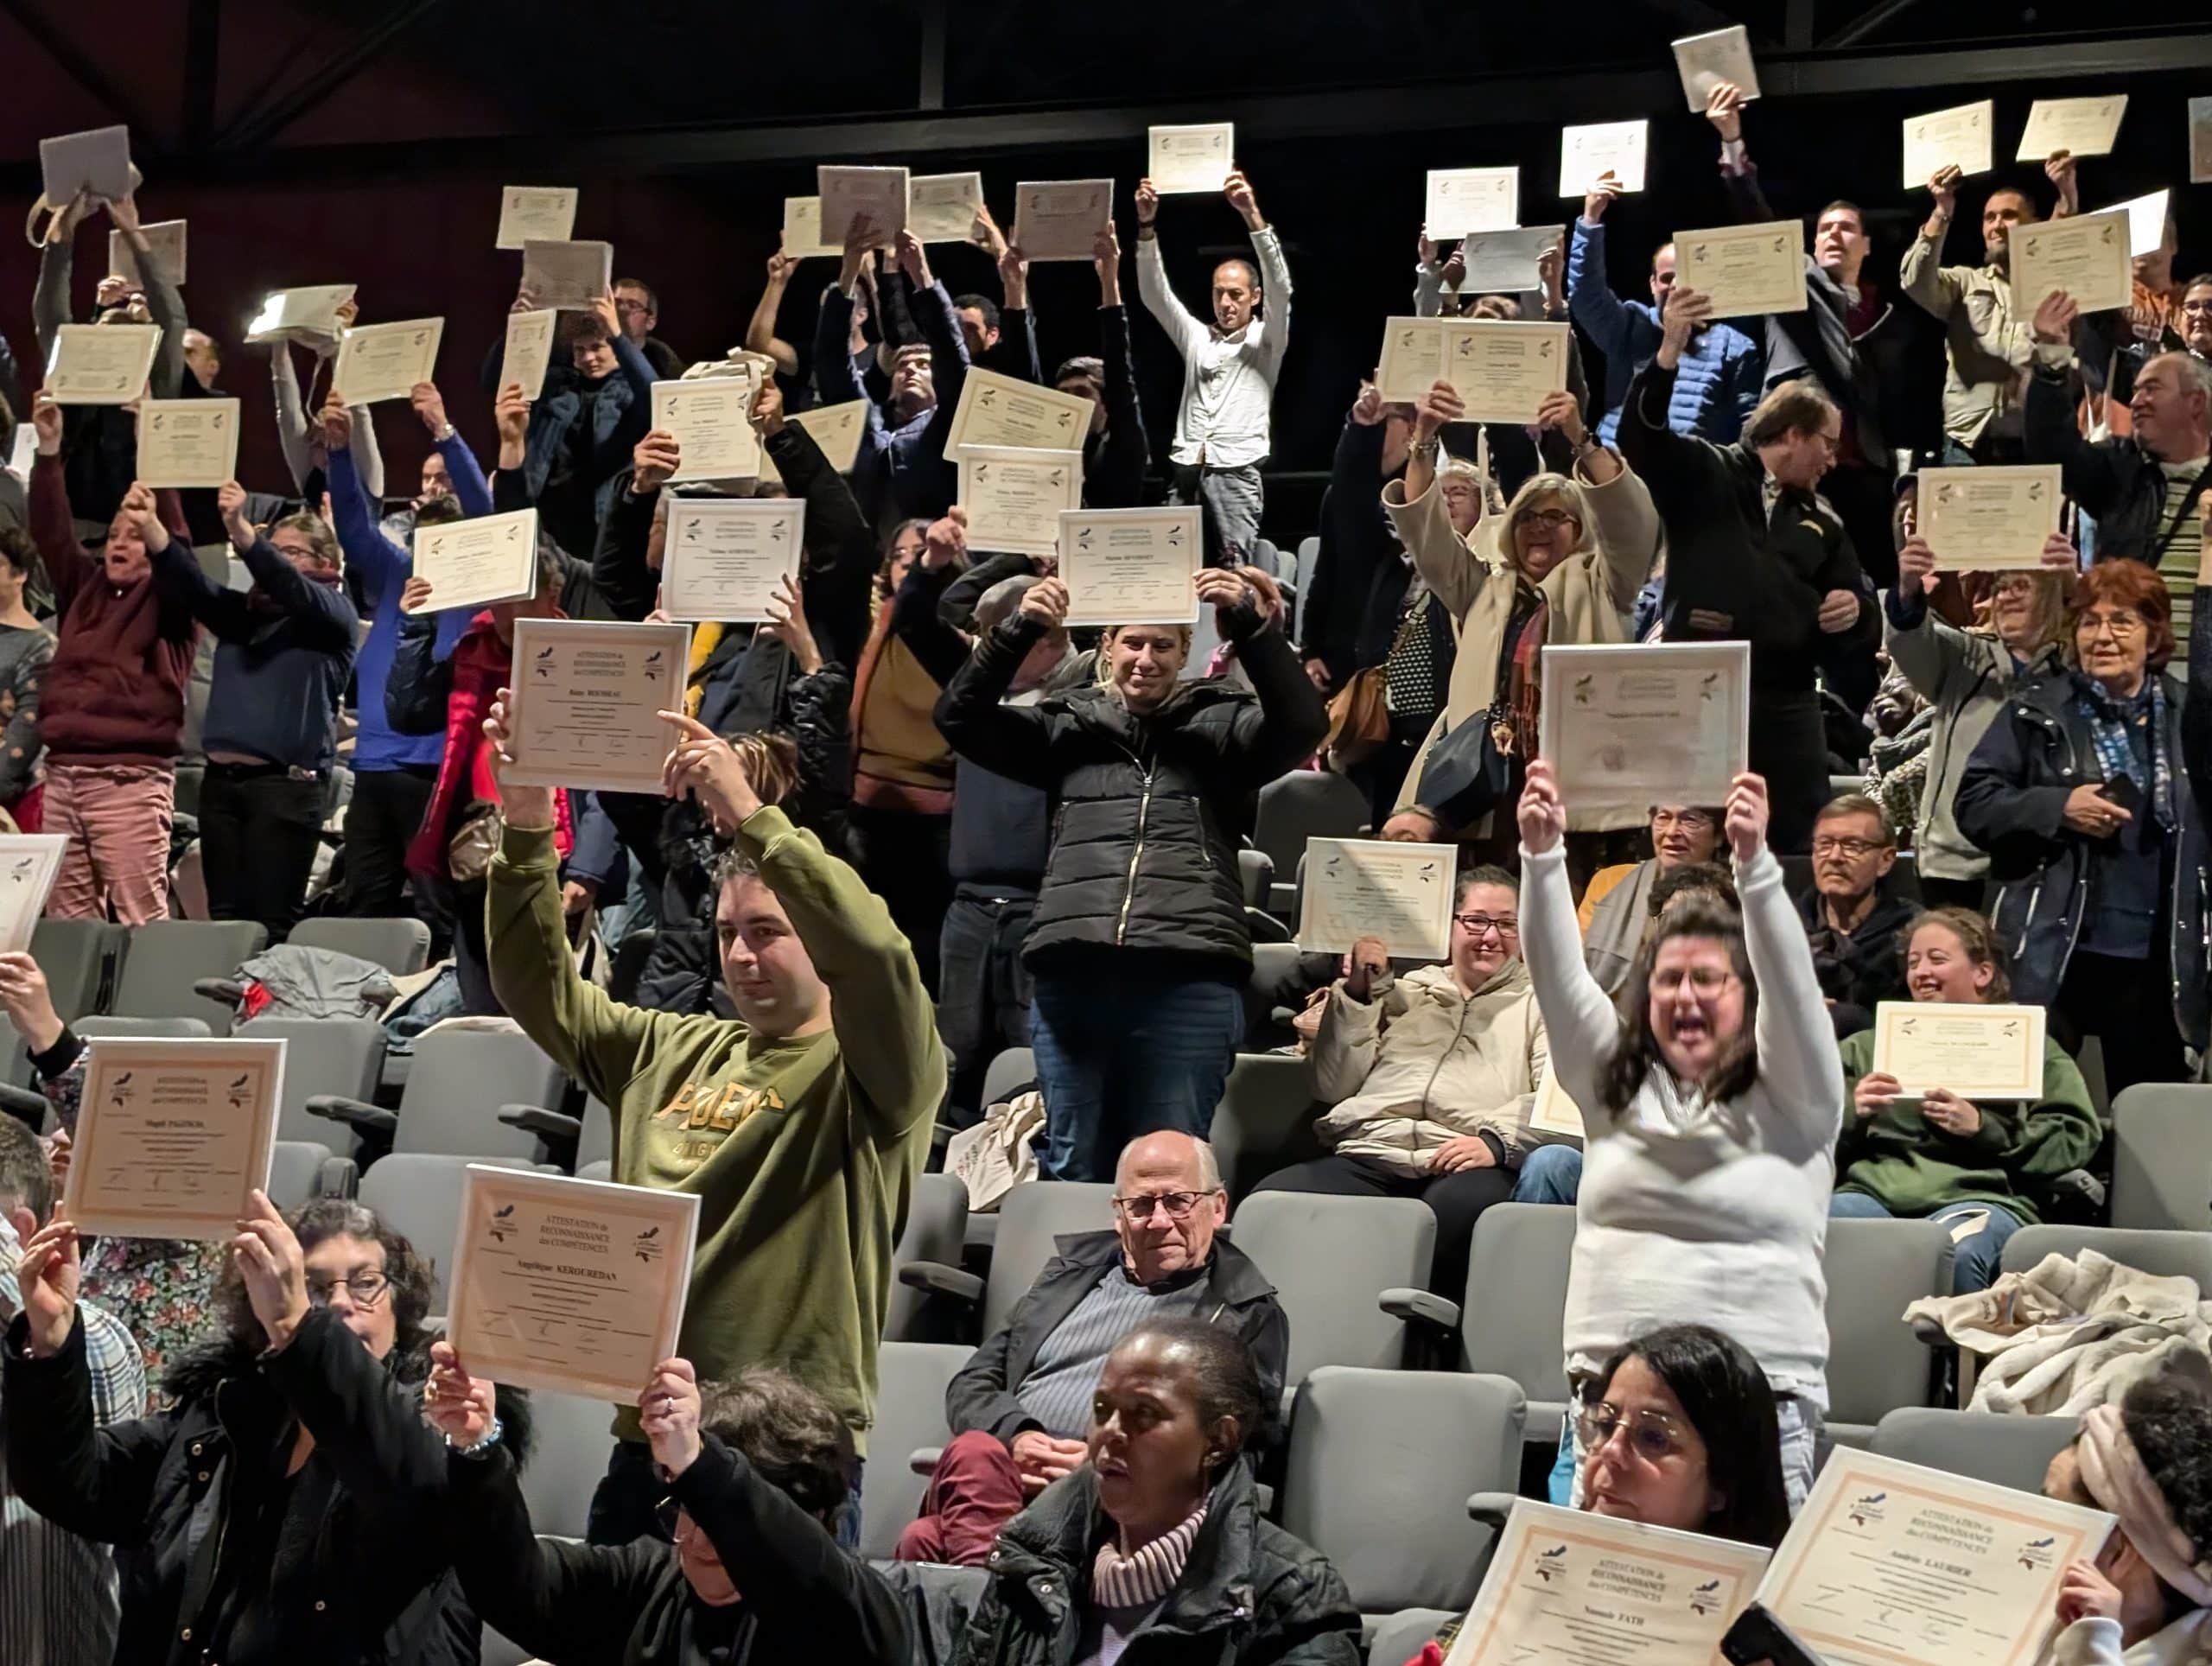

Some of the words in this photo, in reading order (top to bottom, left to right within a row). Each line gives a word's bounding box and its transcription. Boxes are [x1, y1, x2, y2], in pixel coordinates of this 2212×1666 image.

[546, 1215, 599, 1230] ATTESTATION
[540, 1224, 610, 1243] RECONNAISSANCE
[1922, 1509, 1981, 1529] ATTESTATION
[1911, 1517, 1993, 1543] RECONNAISSANCE
[1599, 1559, 1655, 1576] ATTESTATION
[1591, 1568, 1666, 1592] RECONNAISSANCE
